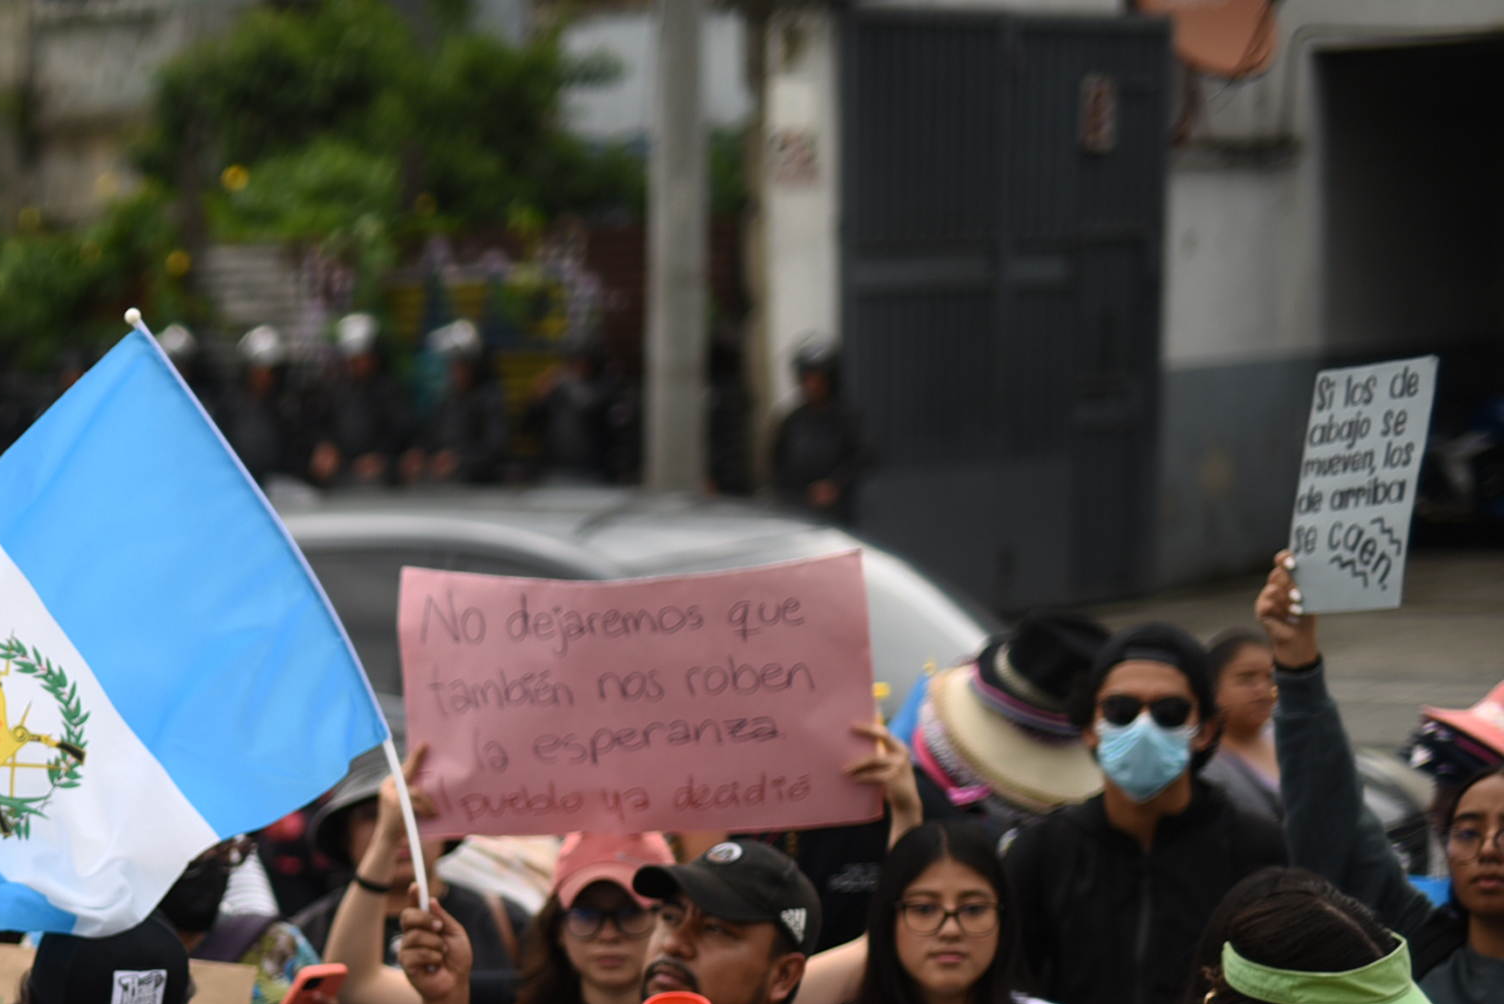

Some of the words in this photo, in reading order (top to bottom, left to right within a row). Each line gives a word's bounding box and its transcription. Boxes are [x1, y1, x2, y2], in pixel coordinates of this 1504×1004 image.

[1315, 375, 1337, 412] Si
[1343, 373, 1377, 408] los
[1389, 365, 1419, 399] de
[1309, 412, 1371, 449] abajo
[1381, 409, 1407, 438] se
[1303, 448, 1376, 478] mueven,
[1383, 441, 1415, 469] los
[1298, 484, 1323, 515] de
[1329, 476, 1406, 511] arriba
[1294, 525, 1317, 556] se
[421, 590, 487, 645] No
[506, 593, 704, 658] dejaremos
[728, 597, 806, 643] que
[427, 662, 575, 716] también
[599, 669, 665, 703] nos
[685, 653, 815, 695] roben
[473, 727, 509, 773] la
[460, 780, 583, 822] pueblo
[600, 786, 650, 822] ya
[673, 772, 812, 812] decidió
